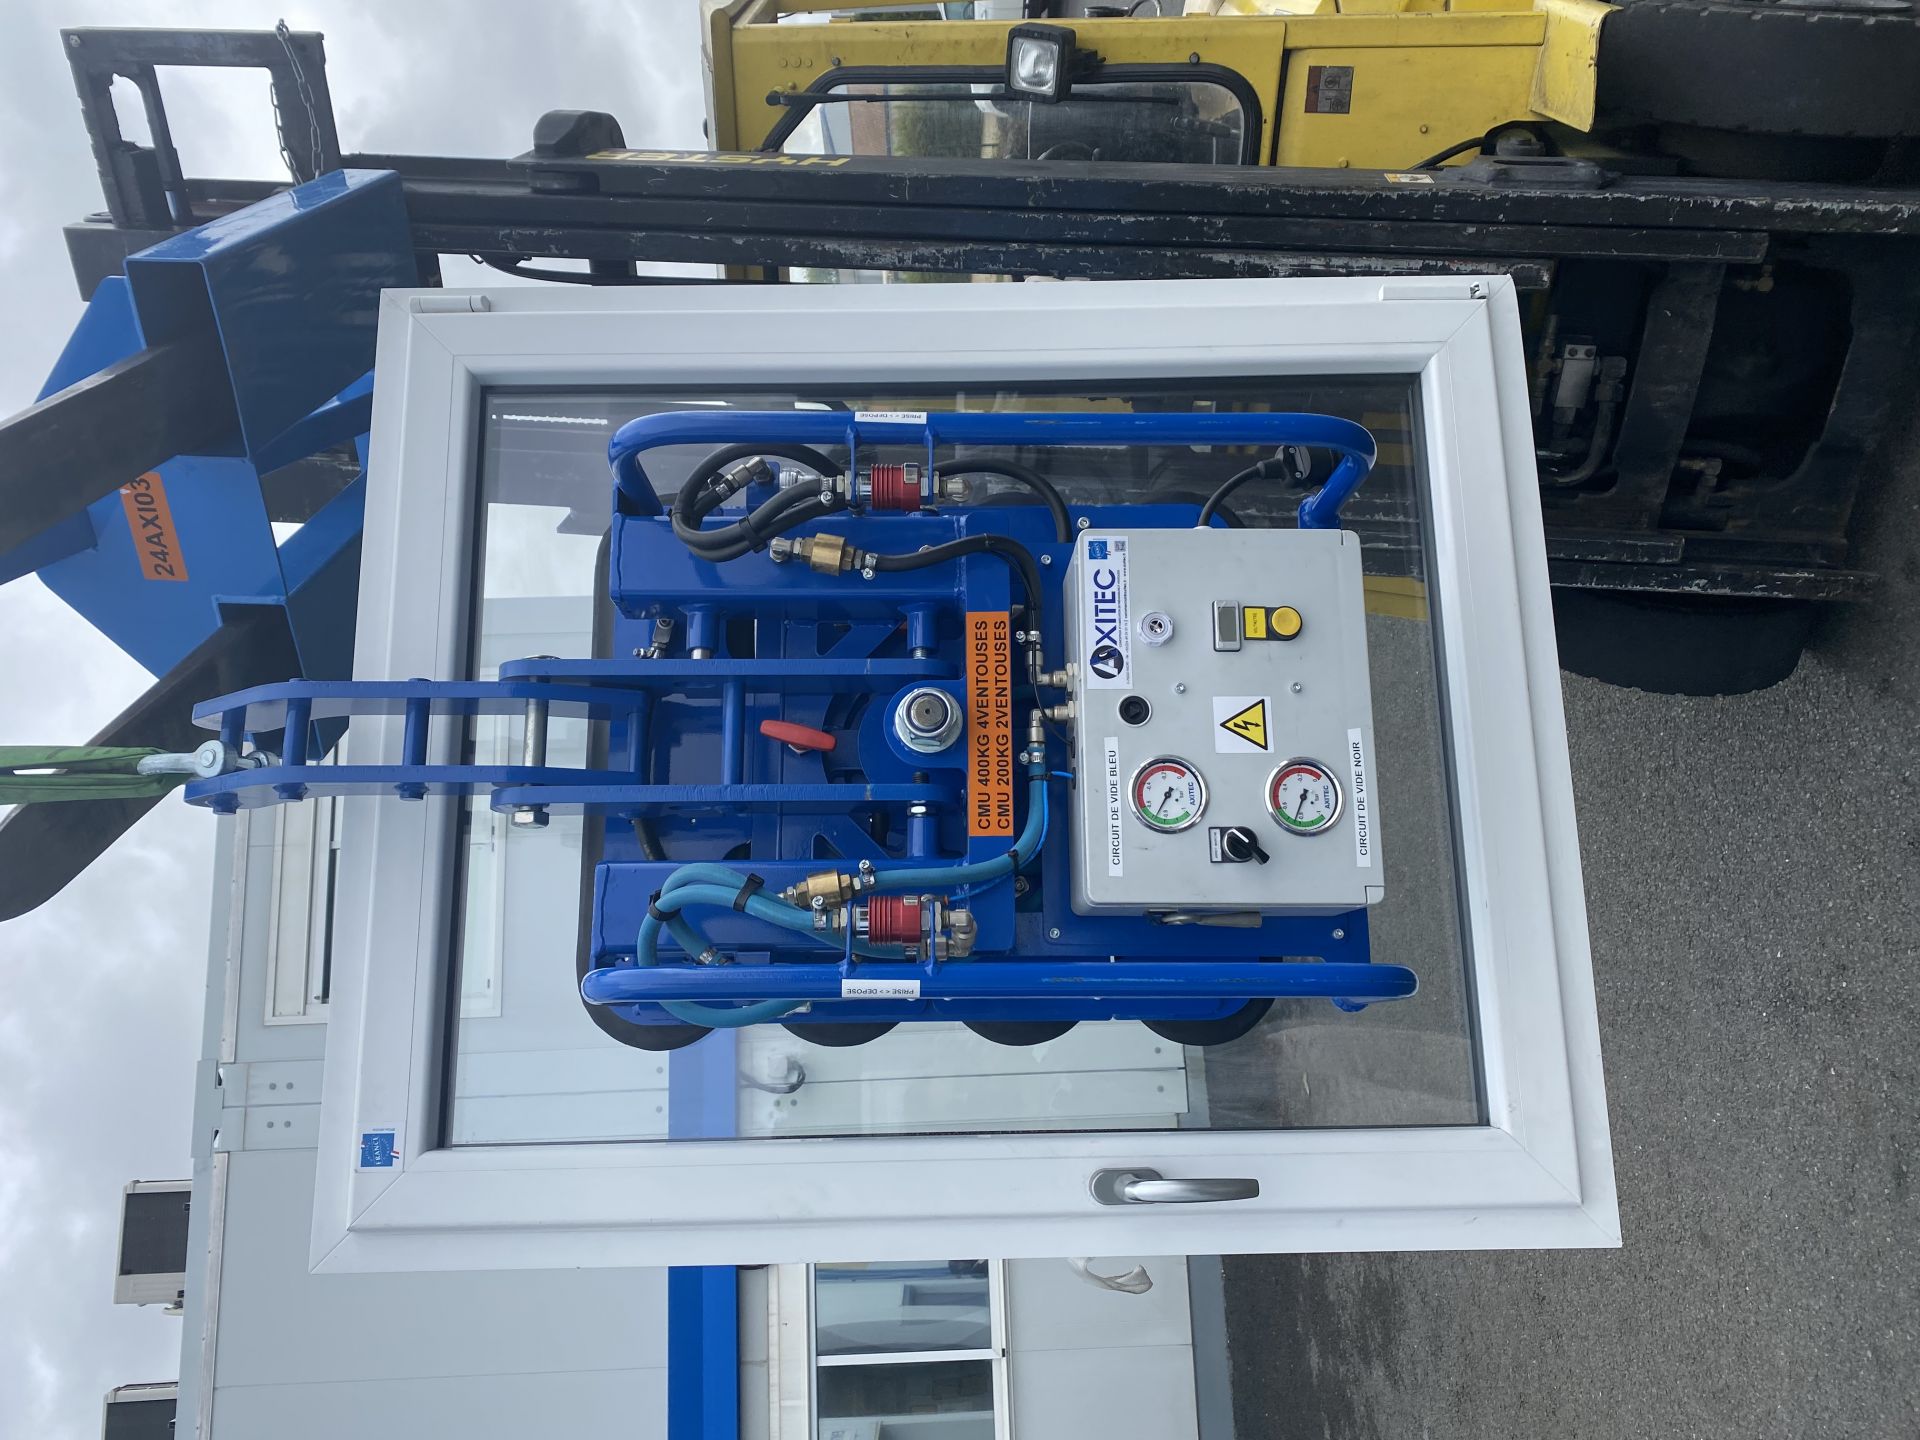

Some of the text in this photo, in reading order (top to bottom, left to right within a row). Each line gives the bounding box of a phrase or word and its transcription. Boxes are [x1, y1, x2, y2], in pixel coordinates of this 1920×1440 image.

[585, 151, 850, 167] HYSTER
[129, 478, 175, 577] 24AXI03
[1089, 569, 1122, 678] AXITEC
[974, 620, 991, 830] CMU 400KG 4VENTOUSES
[993, 620, 1010, 830] CMU 200KG 2VENTOUSES
[1108, 750, 1120, 866] CIRCUIT DE VIDE BLEU
[1187, 781, 1196, 806] AXITEC
[1323, 785, 1331, 809] AXITEC
[1352, 742, 1368, 856] CIRCUIT DE VIDE NOIR
[372, 1136, 382, 1166] FRANCE
